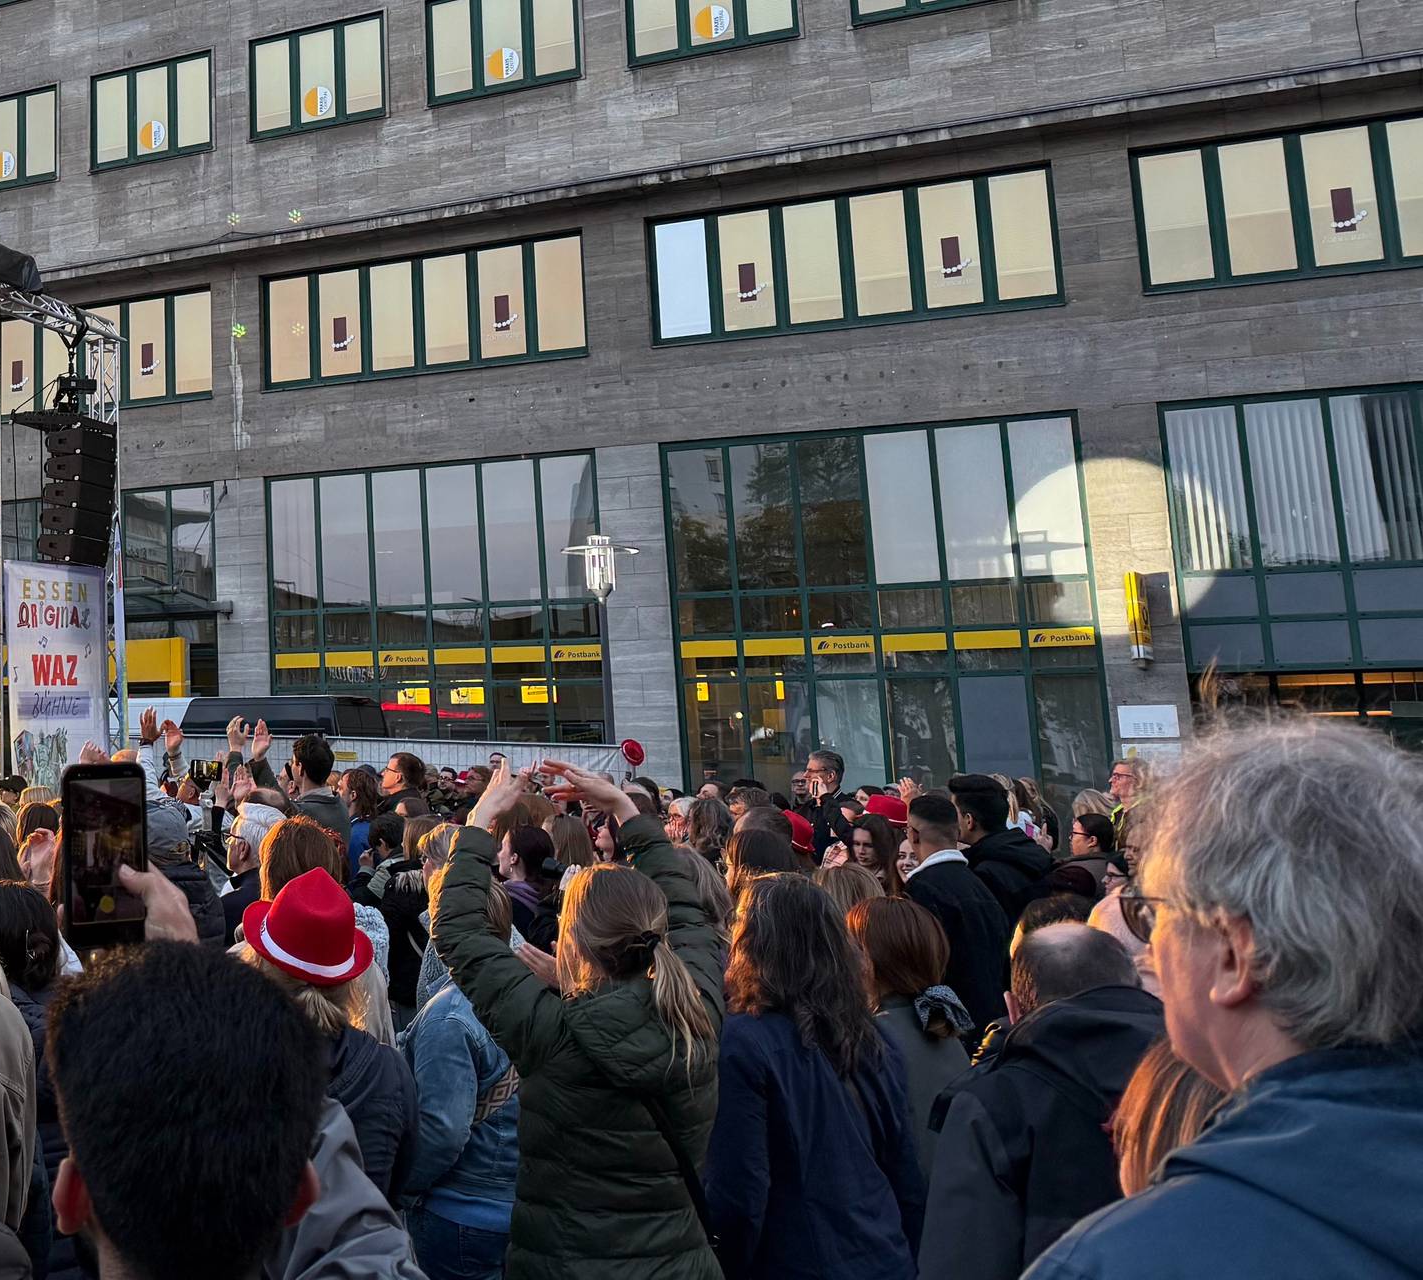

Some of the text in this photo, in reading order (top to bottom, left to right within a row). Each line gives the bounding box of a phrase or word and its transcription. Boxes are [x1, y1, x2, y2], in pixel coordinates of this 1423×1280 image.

[22, 578, 88, 603] ESSEN
[833, 641, 870, 649] Postbank
[1050, 633, 1091, 642] Postbank
[31, 654, 78, 686] WAZ
